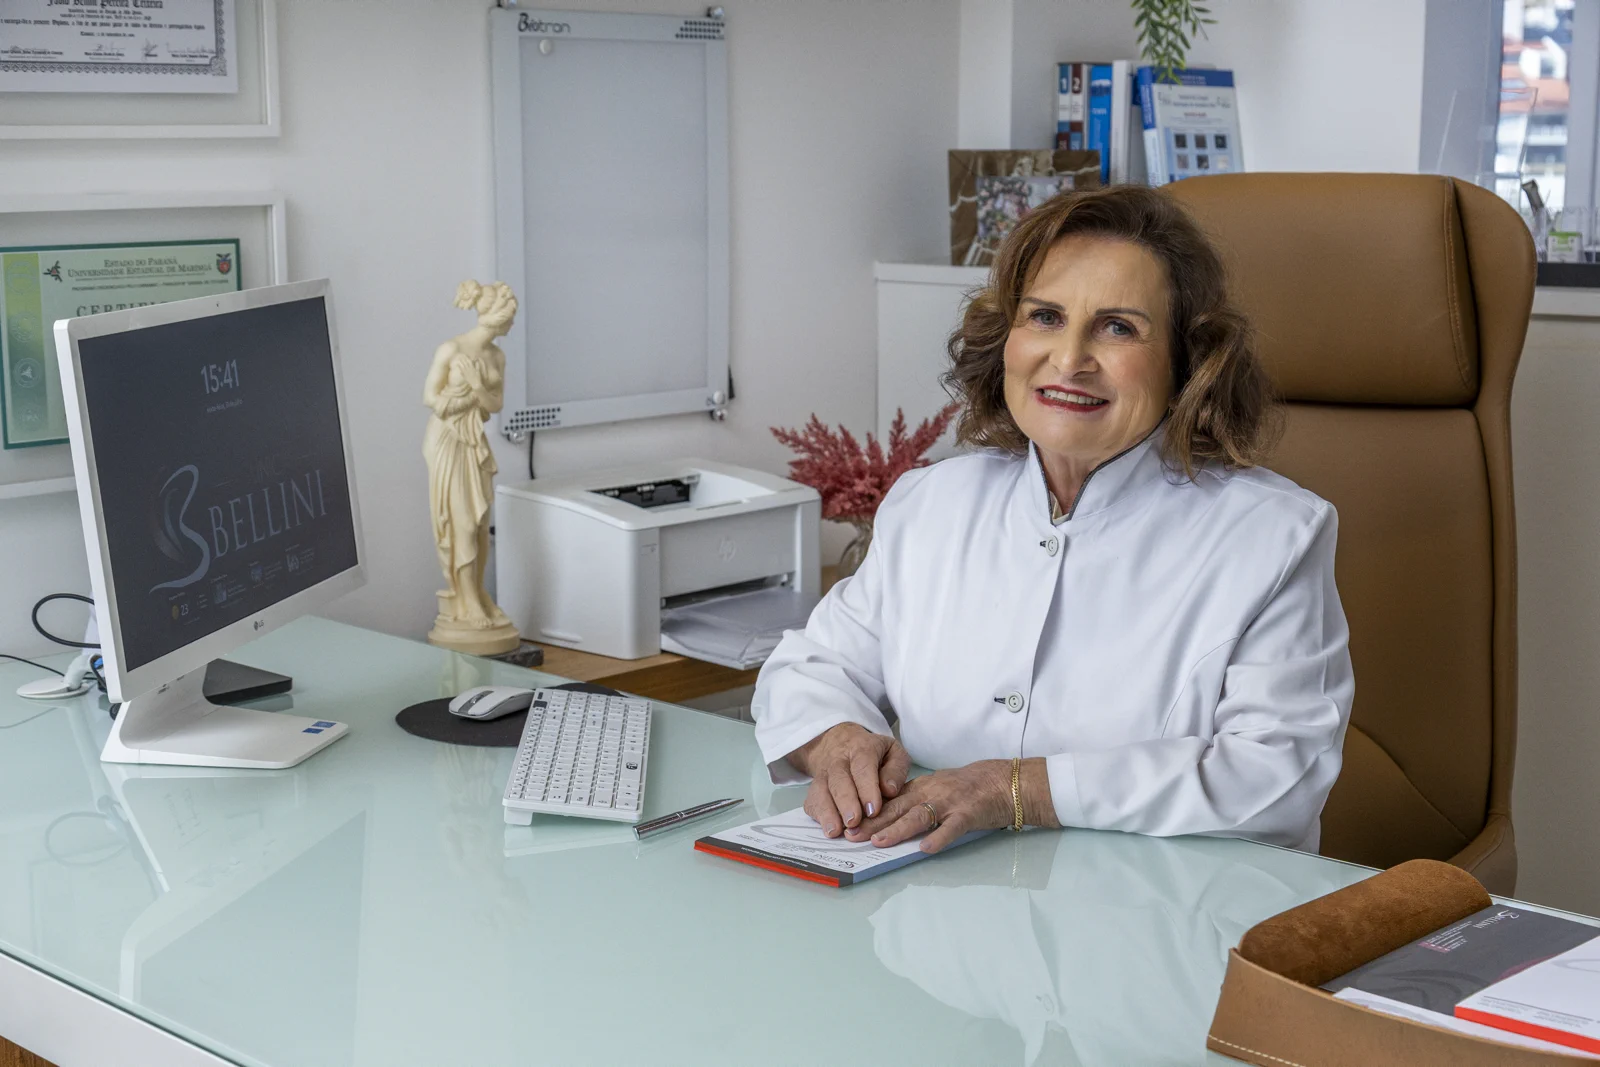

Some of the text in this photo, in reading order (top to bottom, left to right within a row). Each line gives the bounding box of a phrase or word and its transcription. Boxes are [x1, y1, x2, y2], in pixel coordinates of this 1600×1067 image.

[518, 12, 571, 34] Biotron
[1073, 77, 1080, 91] 2
[200, 359, 240, 394] 15:41
[208, 469, 327, 561] BELLINI
[181, 604, 189, 616] 23
